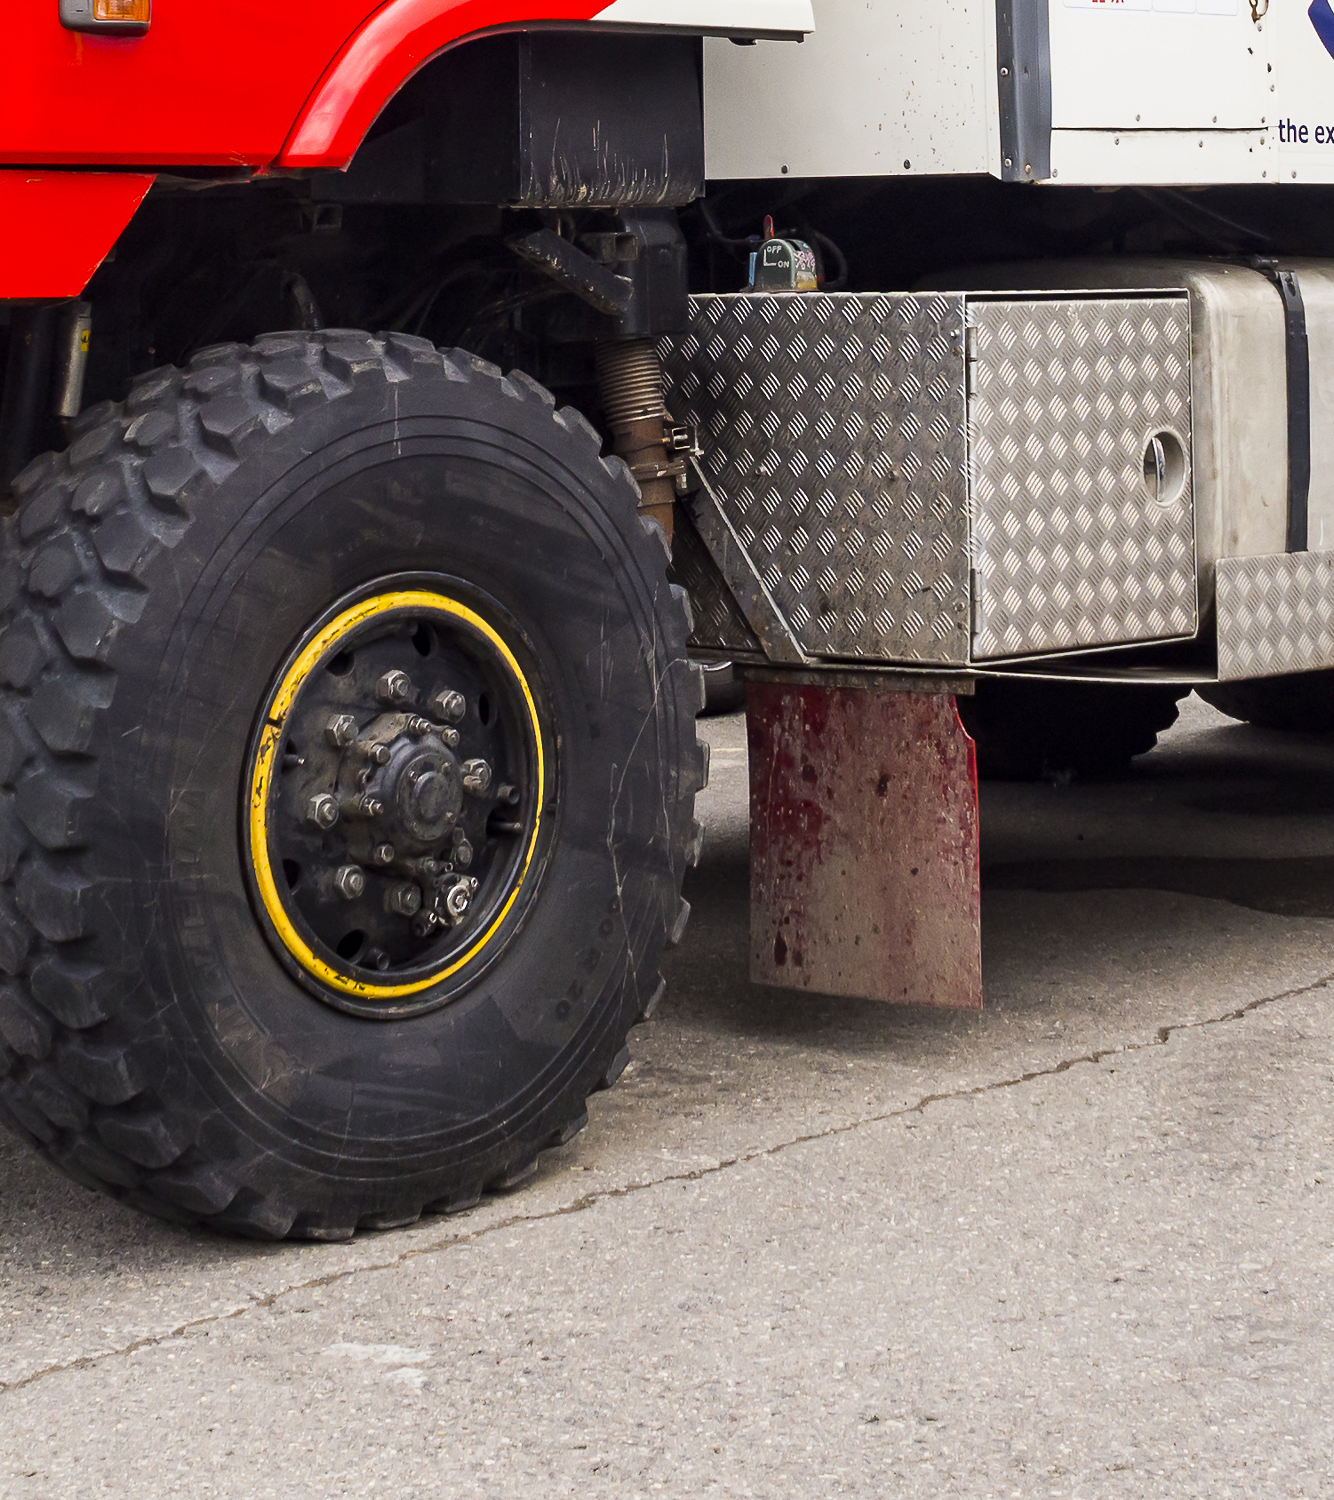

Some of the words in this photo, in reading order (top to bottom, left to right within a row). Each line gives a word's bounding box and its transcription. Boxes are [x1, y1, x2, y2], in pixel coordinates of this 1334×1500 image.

[1278, 117, 1308, 144] the
[767, 245, 782, 254] OFF
[777, 260, 790, 268] ON
